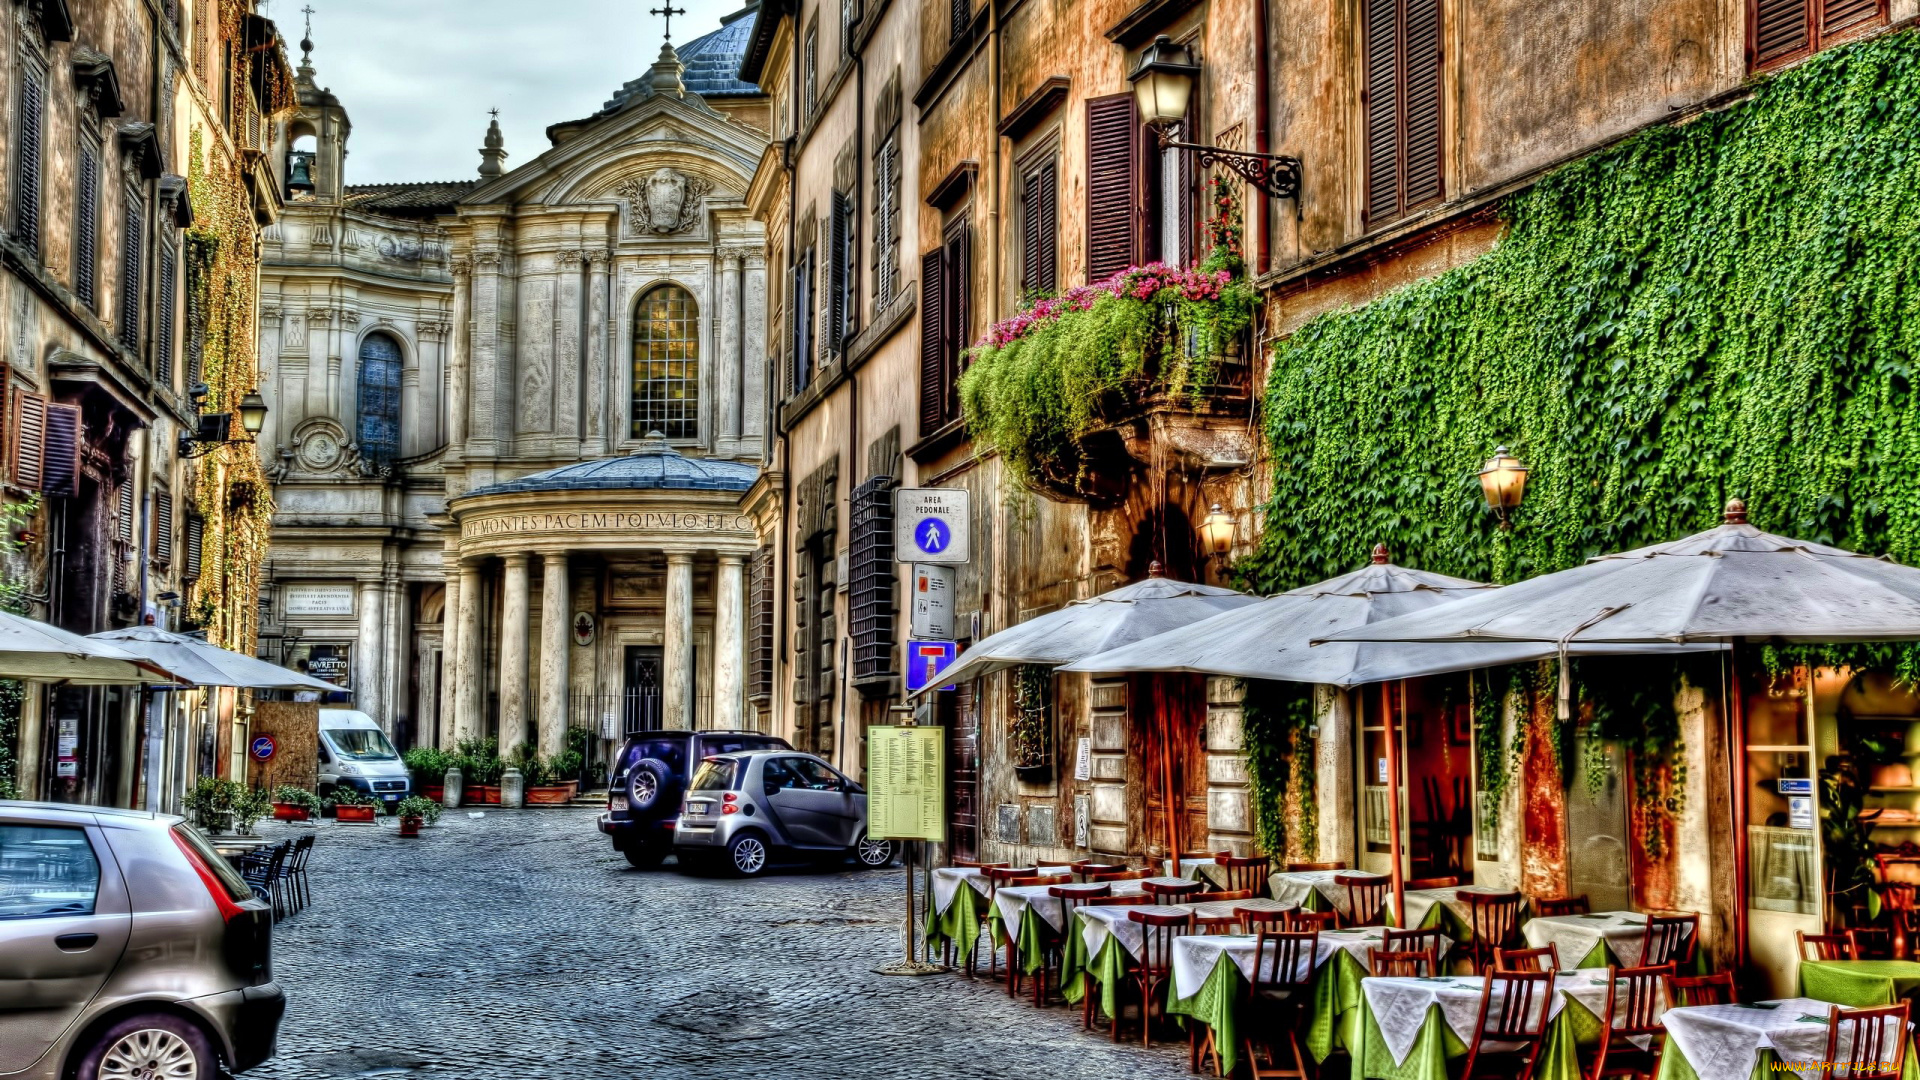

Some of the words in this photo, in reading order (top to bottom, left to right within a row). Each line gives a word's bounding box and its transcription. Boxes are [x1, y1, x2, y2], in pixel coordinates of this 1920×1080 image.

[924, 496, 942, 504] AREA
[915, 506, 950, 514] PEDONALE
[480, 515, 537, 533] MONTES
[545, 513, 607, 529] PACEM
[615, 513, 697, 528] POPVLO
[707, 514, 725, 529] ET
